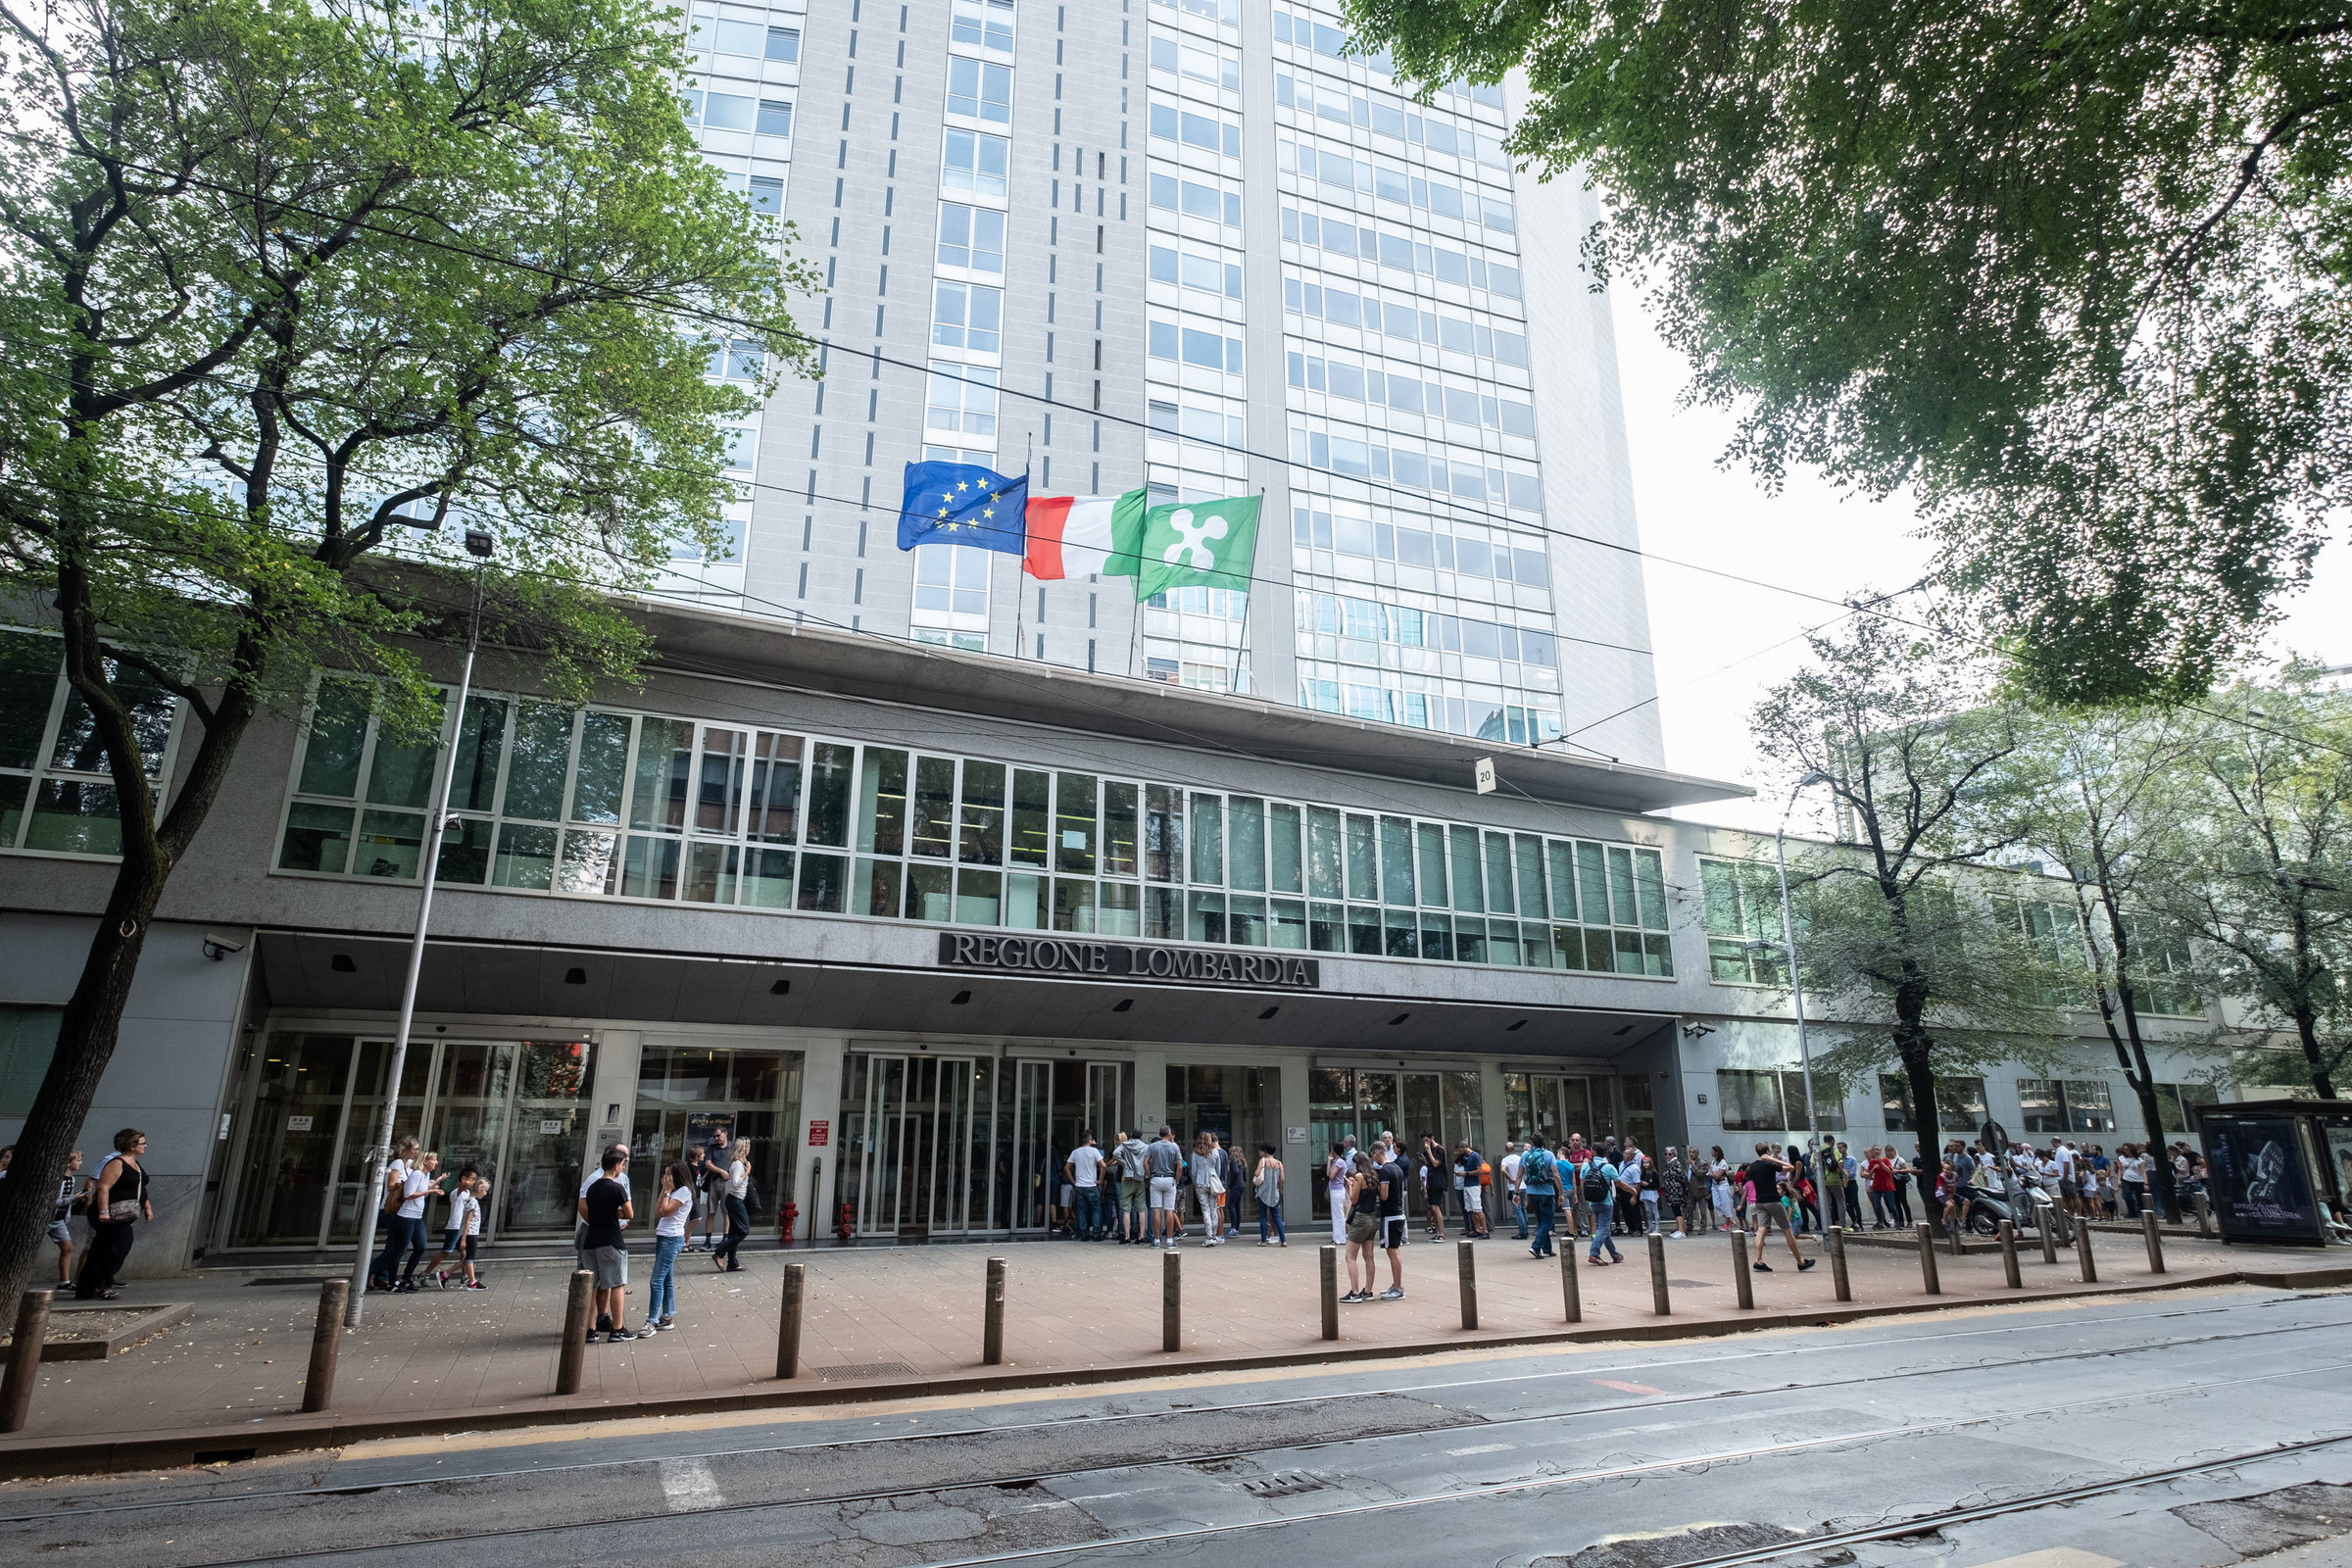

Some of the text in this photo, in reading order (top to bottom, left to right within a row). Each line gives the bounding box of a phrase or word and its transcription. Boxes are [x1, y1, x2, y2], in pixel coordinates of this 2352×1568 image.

[1480, 770, 1491, 783] 20
[952, 934, 1311, 985] REGIONE LOMBARDIA
